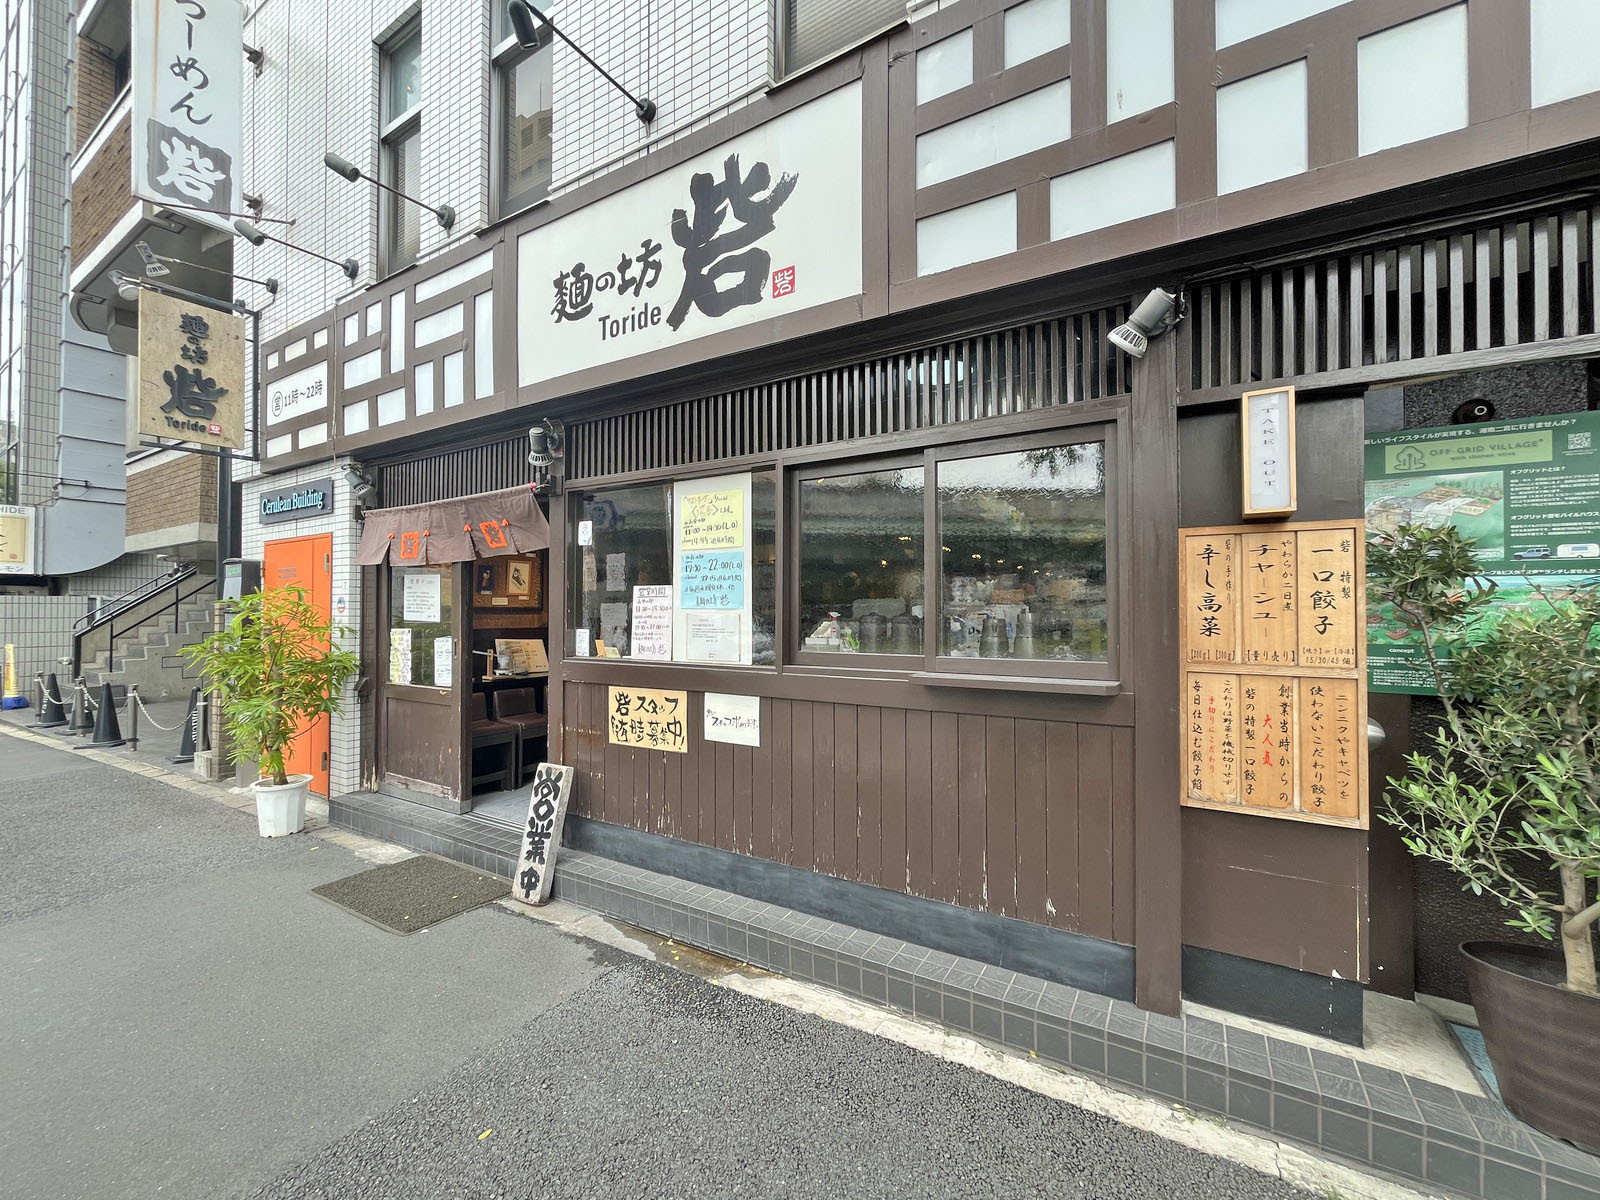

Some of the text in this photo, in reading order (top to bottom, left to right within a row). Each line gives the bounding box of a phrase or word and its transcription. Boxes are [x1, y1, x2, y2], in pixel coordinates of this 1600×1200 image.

[598, 301, 662, 341] Toride
[164, 415, 207, 433] Toride
[1261, 407, 1276, 486] TAKE OUT
[1457, 445, 1485, 454] GRID
[1489, 440, 1538, 451] VILLAGE
[261, 488, 323, 515] Cerulean Building
[1196, 544, 1222, 637] 辛し高菜
[1310, 548, 1336, 635] 一口餃子
[1279, 684, 1290, 802] 創業当時からの
[1310, 686, 1326, 807] 使わないこだわり餃子
